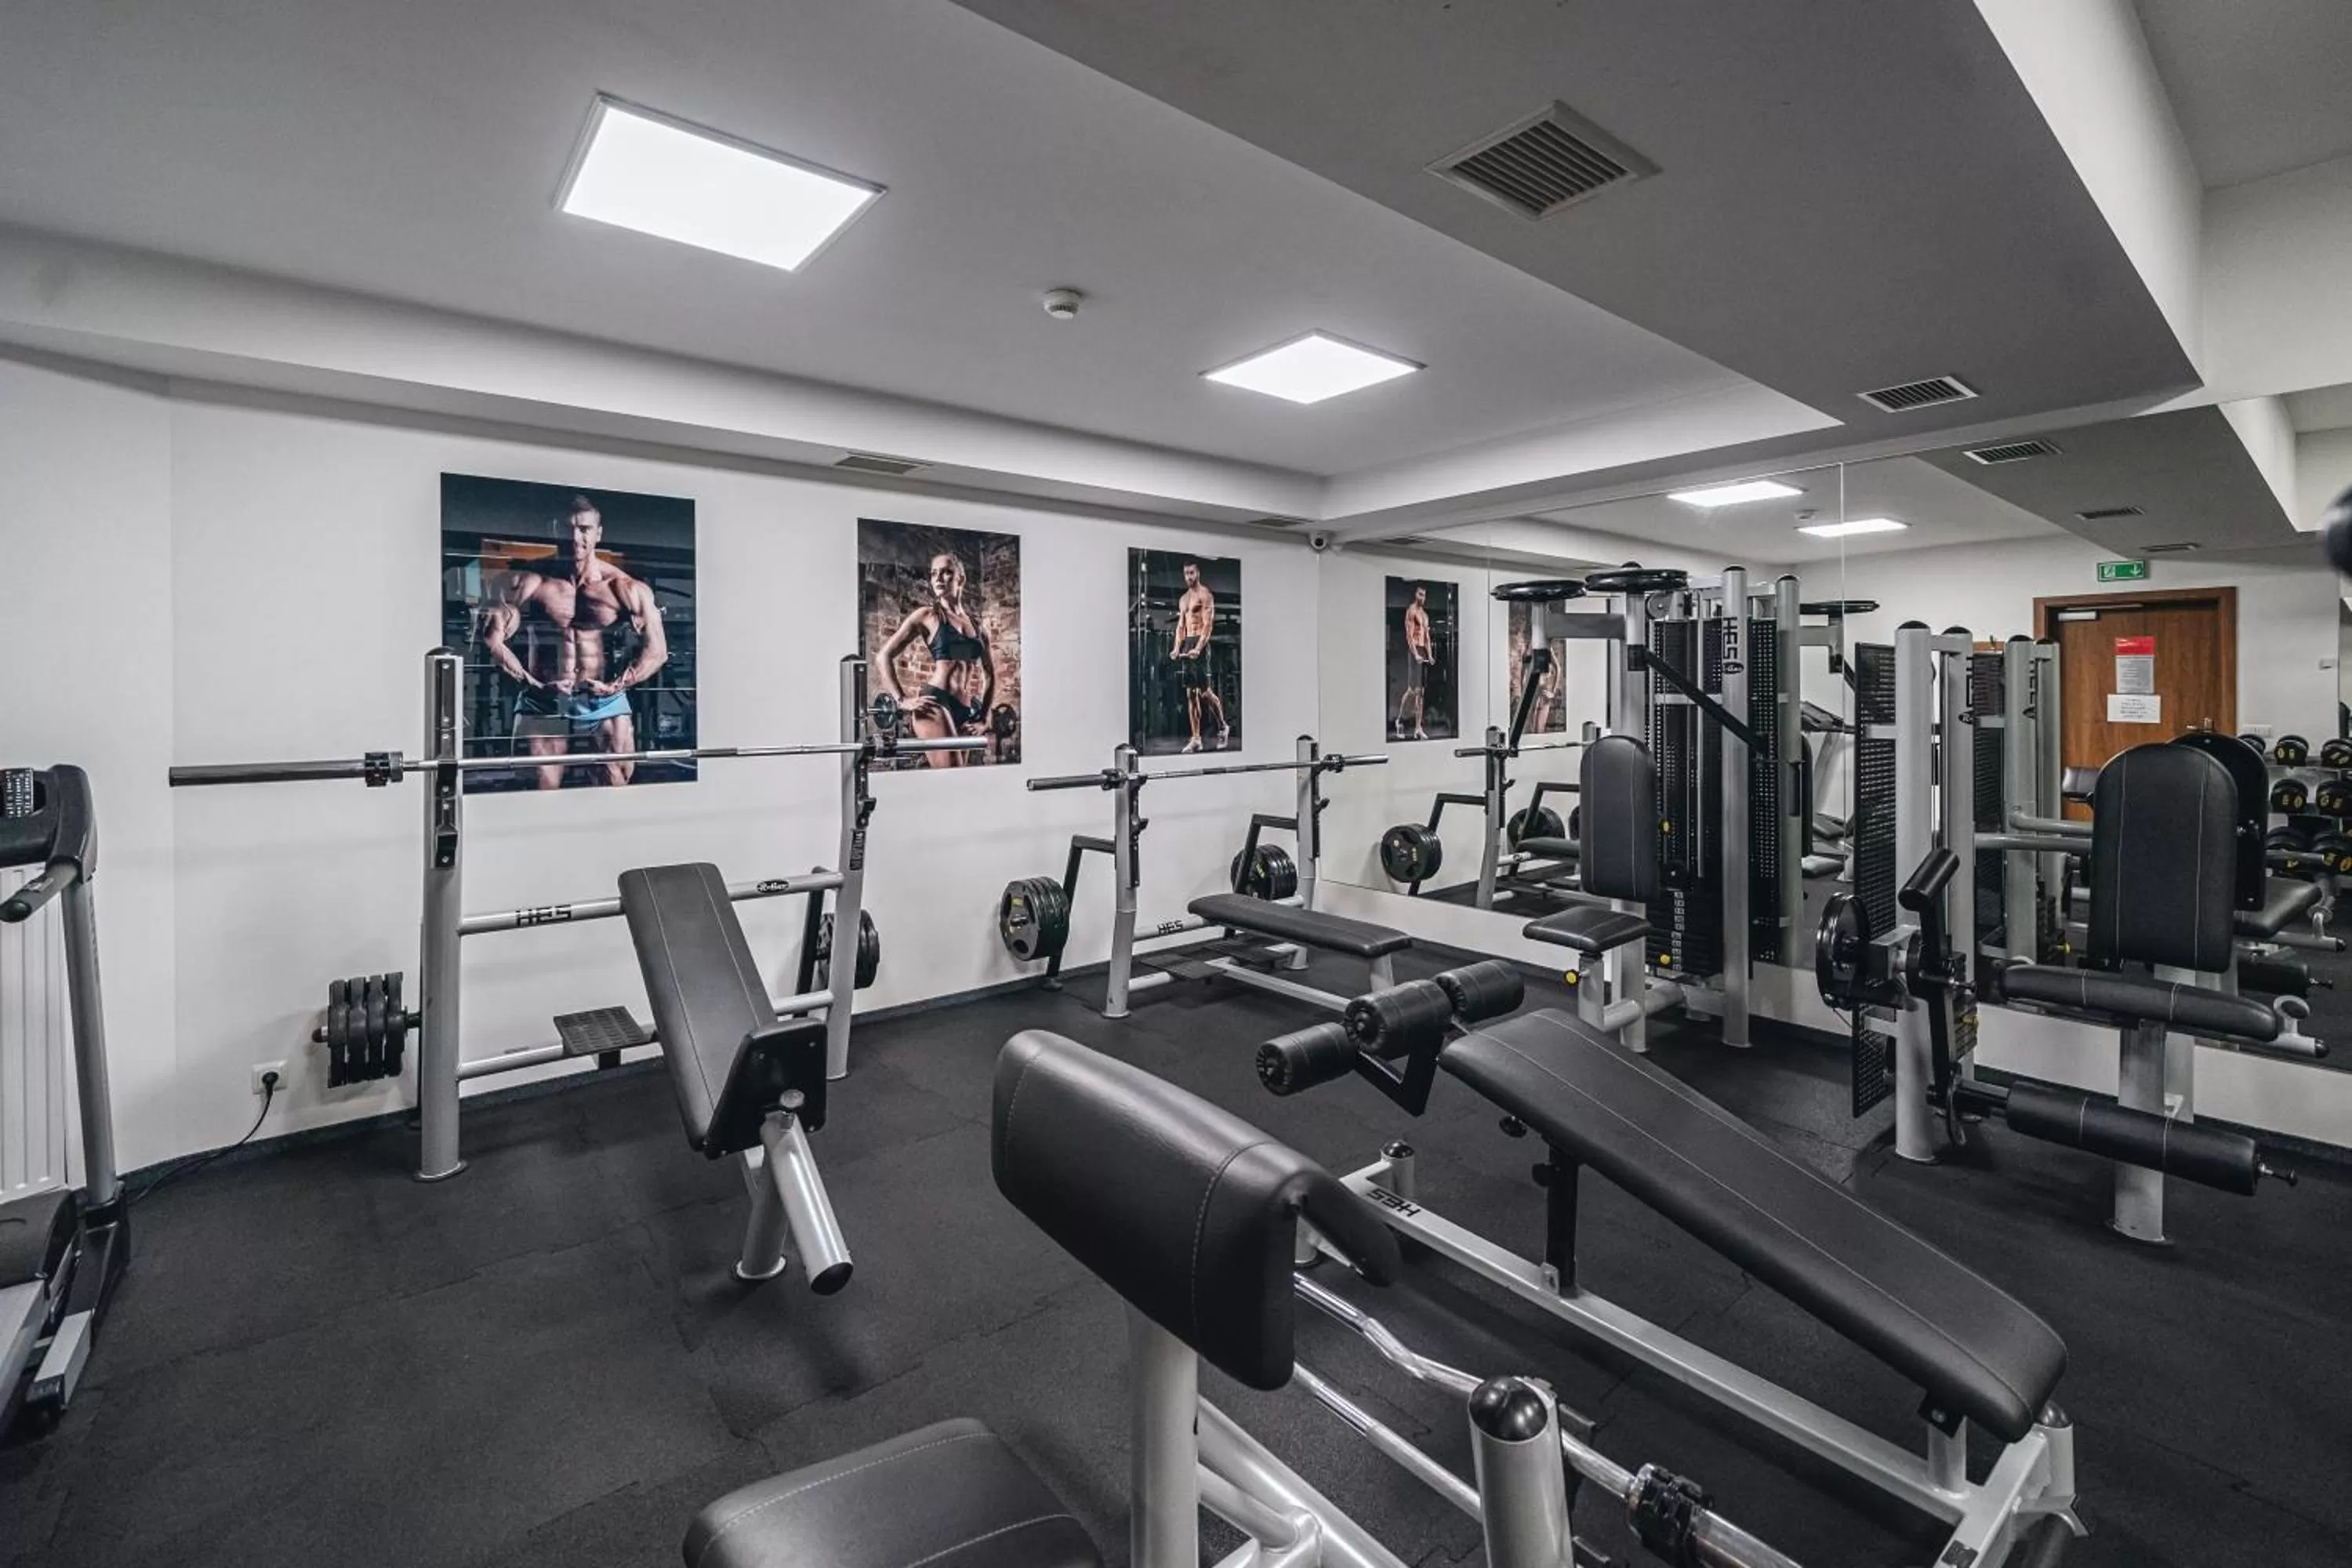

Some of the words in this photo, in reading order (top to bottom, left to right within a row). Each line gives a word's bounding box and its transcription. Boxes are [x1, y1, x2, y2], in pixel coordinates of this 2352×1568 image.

[1723, 617, 1737, 659] HES
[515, 904, 571, 926] HES
[1367, 1189, 1421, 1217] HES
